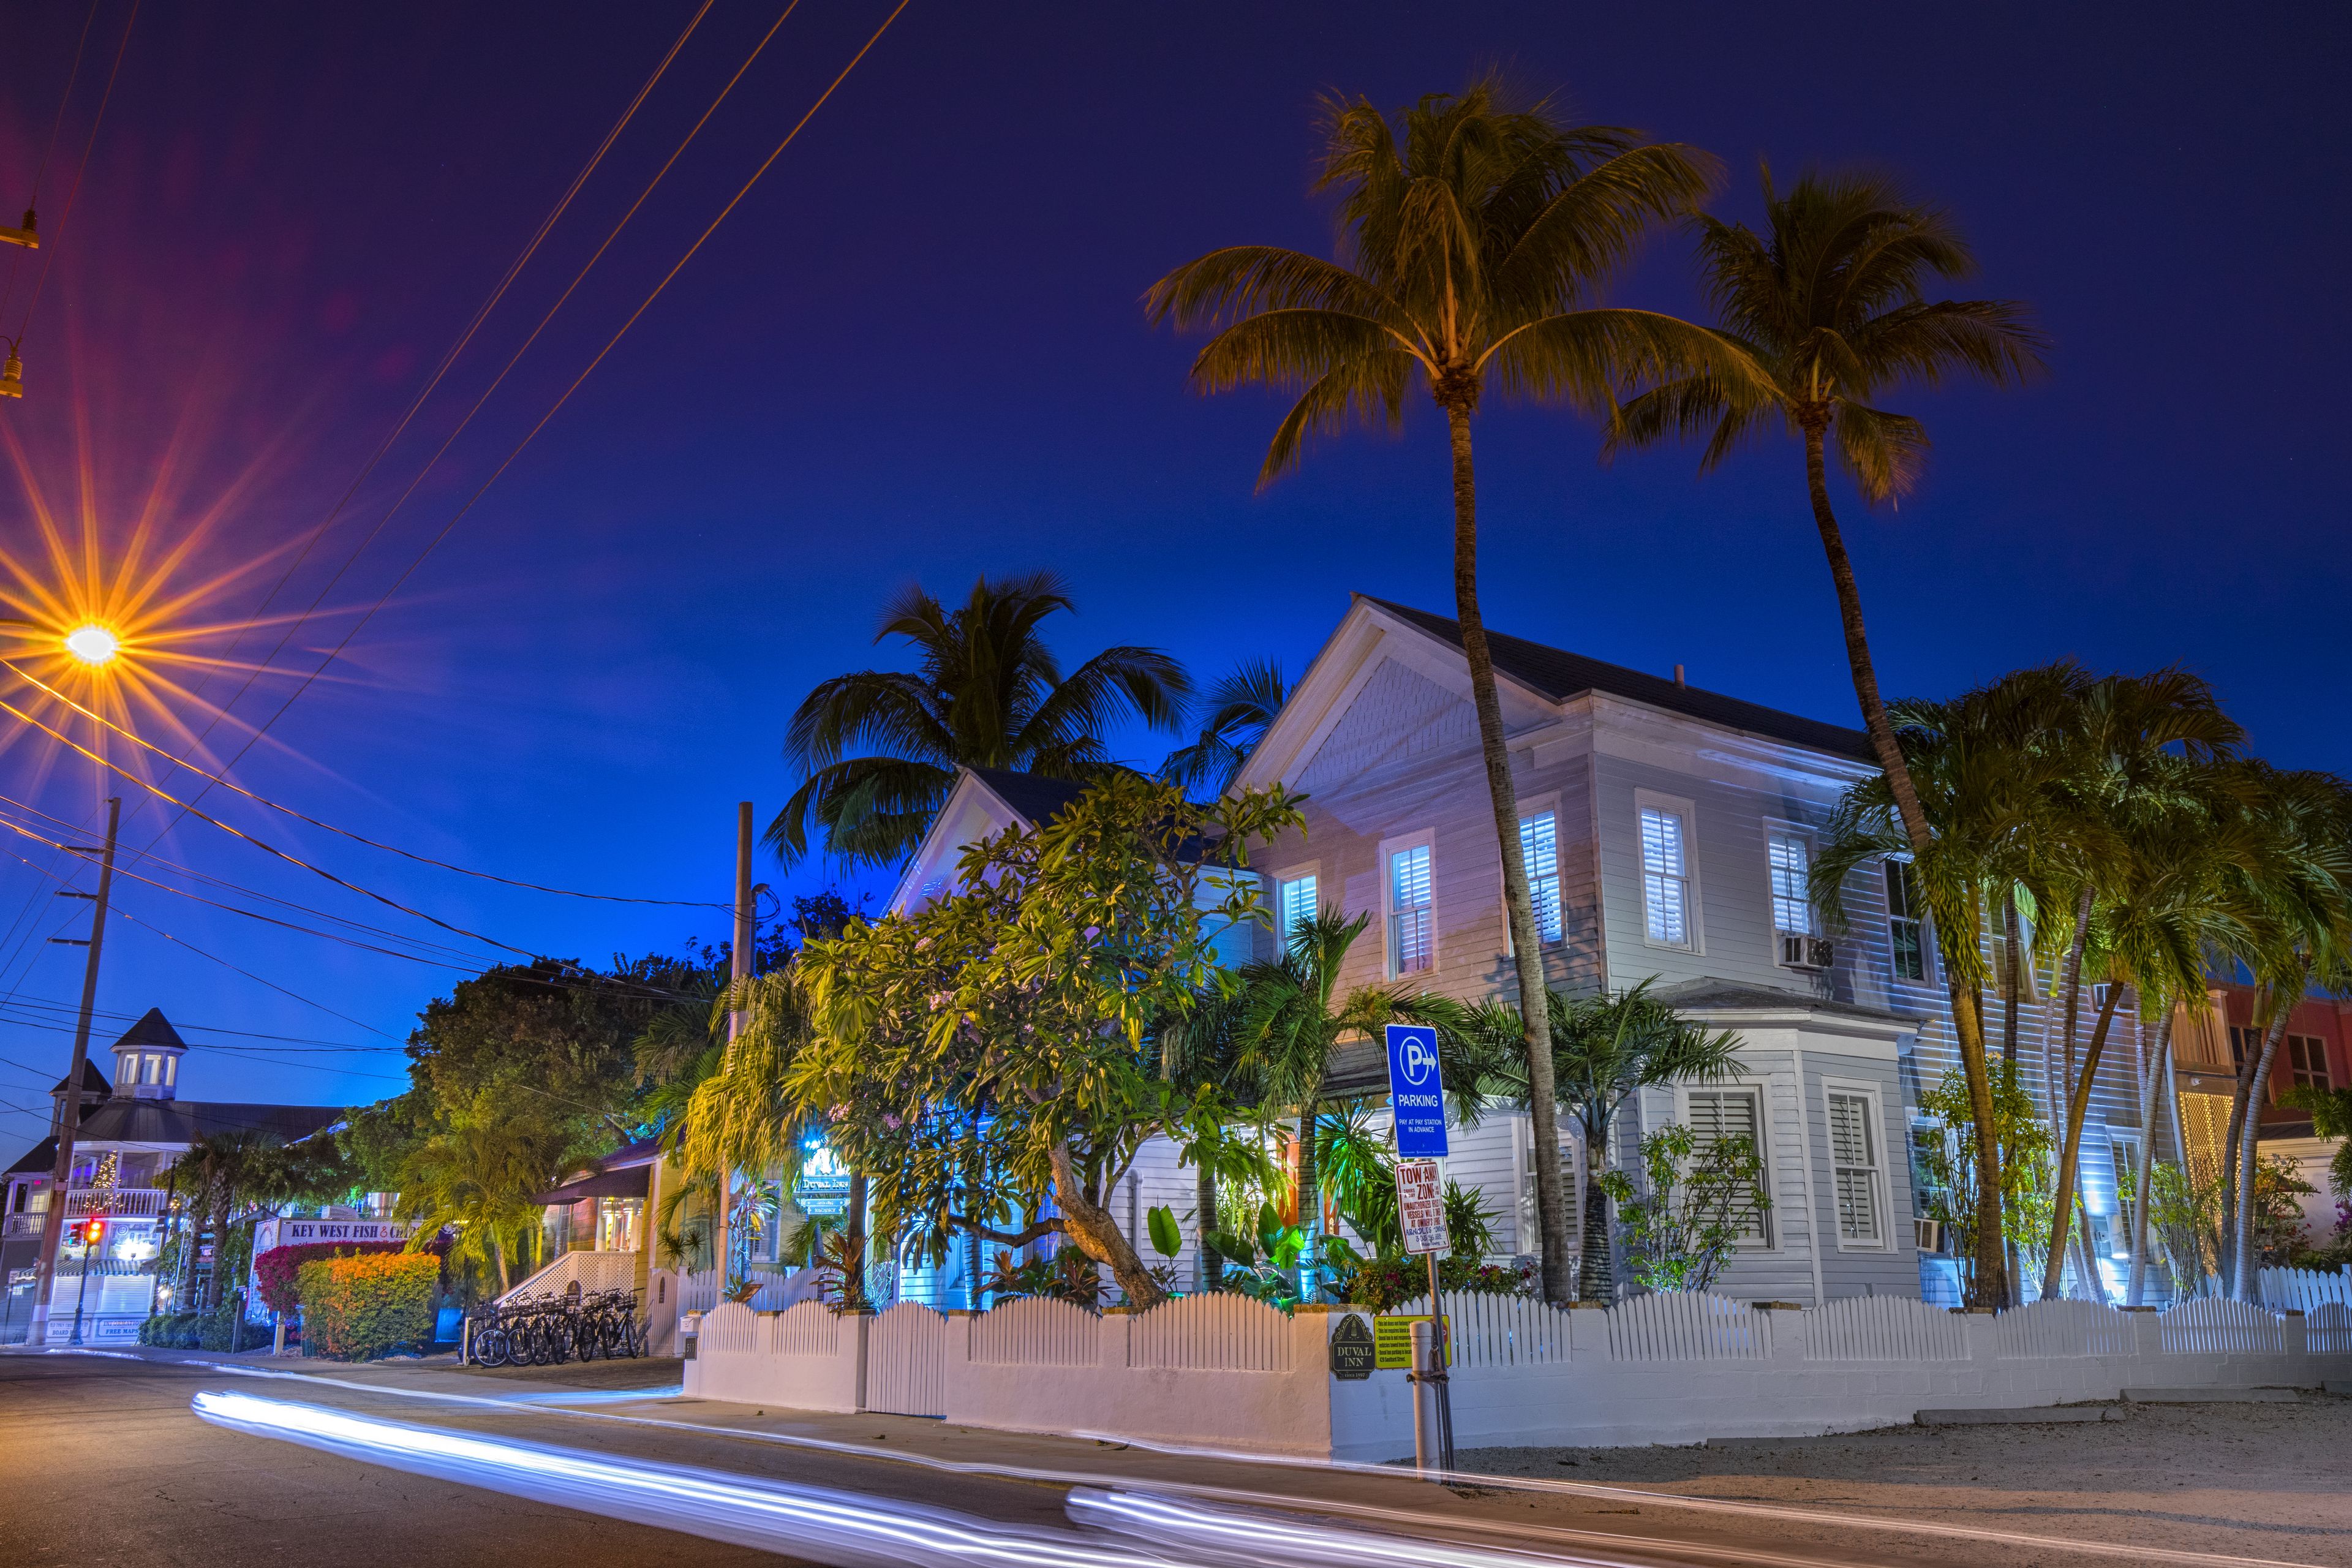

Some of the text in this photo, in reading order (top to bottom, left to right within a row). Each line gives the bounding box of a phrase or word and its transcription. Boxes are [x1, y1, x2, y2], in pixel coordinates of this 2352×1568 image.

[1408, 1045, 1422, 1077] P
[1398, 1094, 1438, 1107] PARKING
[1400, 1166, 1438, 1184] TOW AWAY
[1417, 1183, 1434, 1200] ZONE
[1404, 1200, 1431, 1210] UNAUTHORIZED
[1407, 1210, 1423, 1219] VESSELS
[1411, 1219, 1415, 1228] AT
[292, 1224, 315, 1237] KEY
[319, 1225, 350, 1237] WEST
[353, 1226, 379, 1238] FISH
[380, 1226, 388, 1238] &
[1338, 1347, 1371, 1356] DUVAL
[1344, 1357, 1364, 1366] INN
